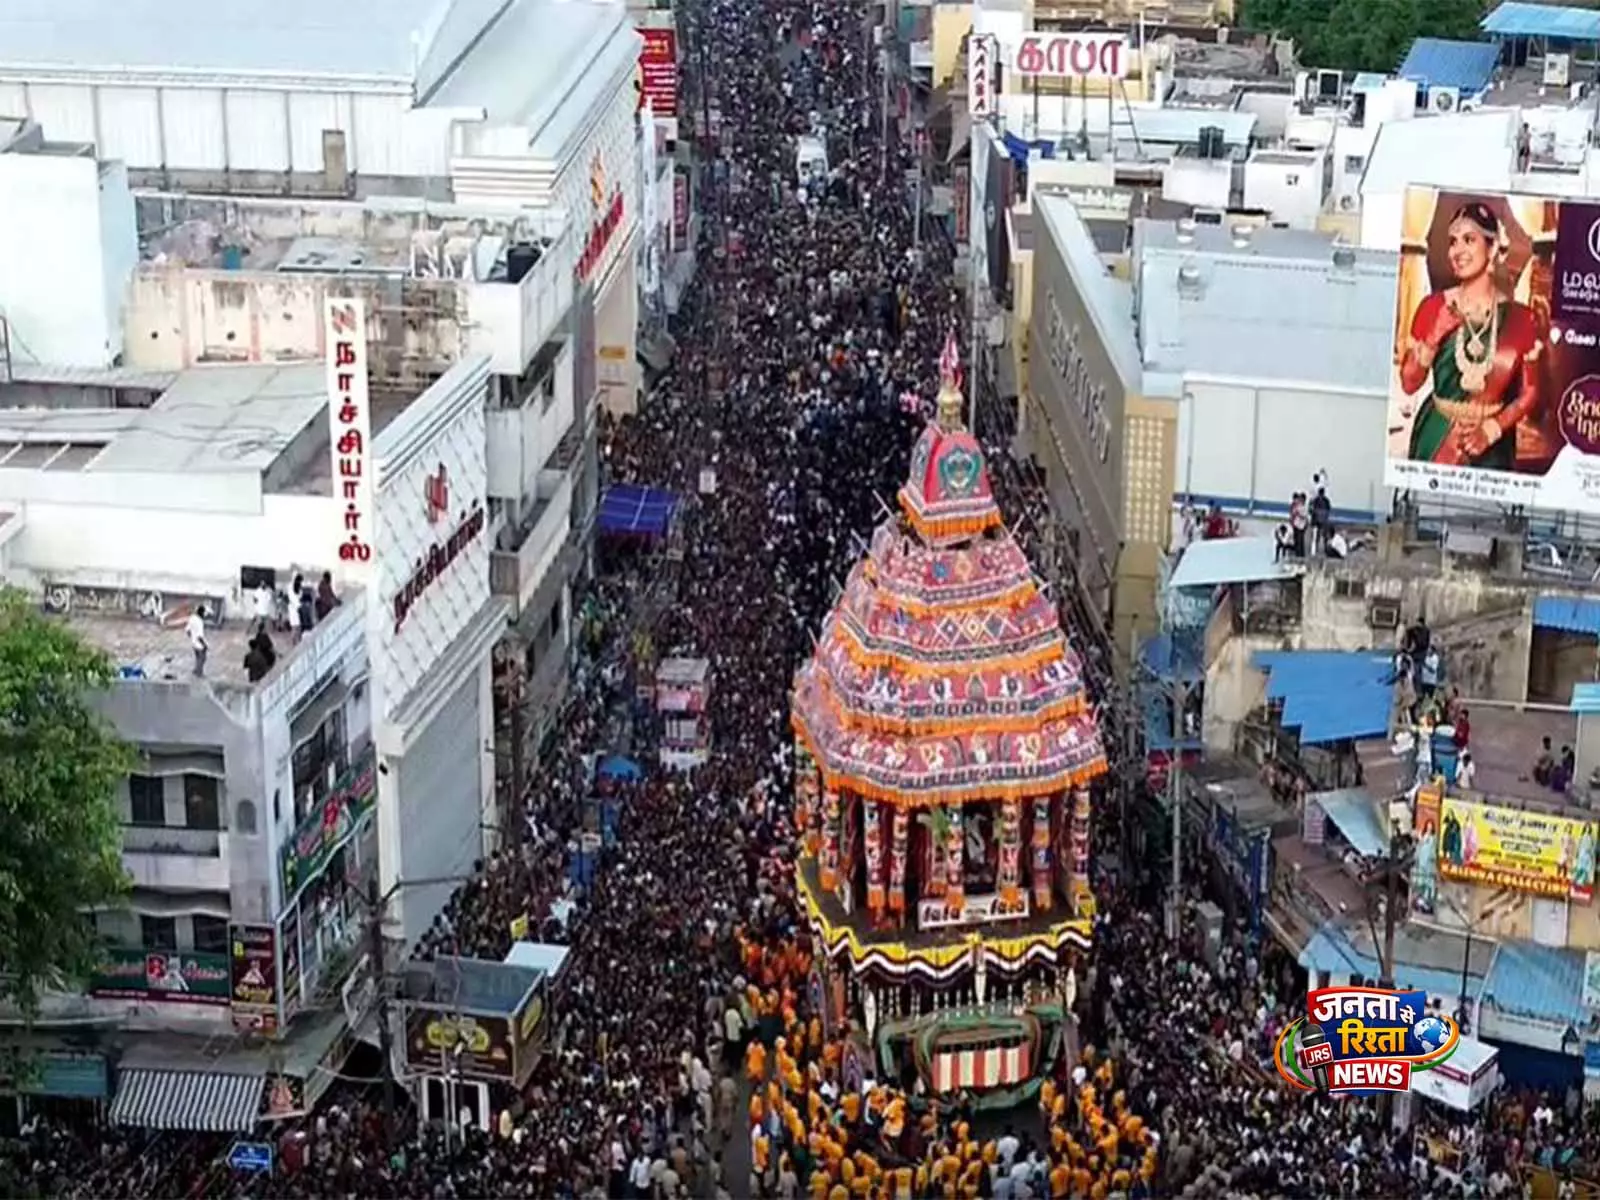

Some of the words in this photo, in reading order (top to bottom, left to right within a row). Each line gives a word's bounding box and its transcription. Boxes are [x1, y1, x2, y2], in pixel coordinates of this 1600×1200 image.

[972, 36, 989, 111] KAABA
[1017, 37, 1123, 75] காபா
[336, 342, 371, 562] நாச்சியார்ஸ்
